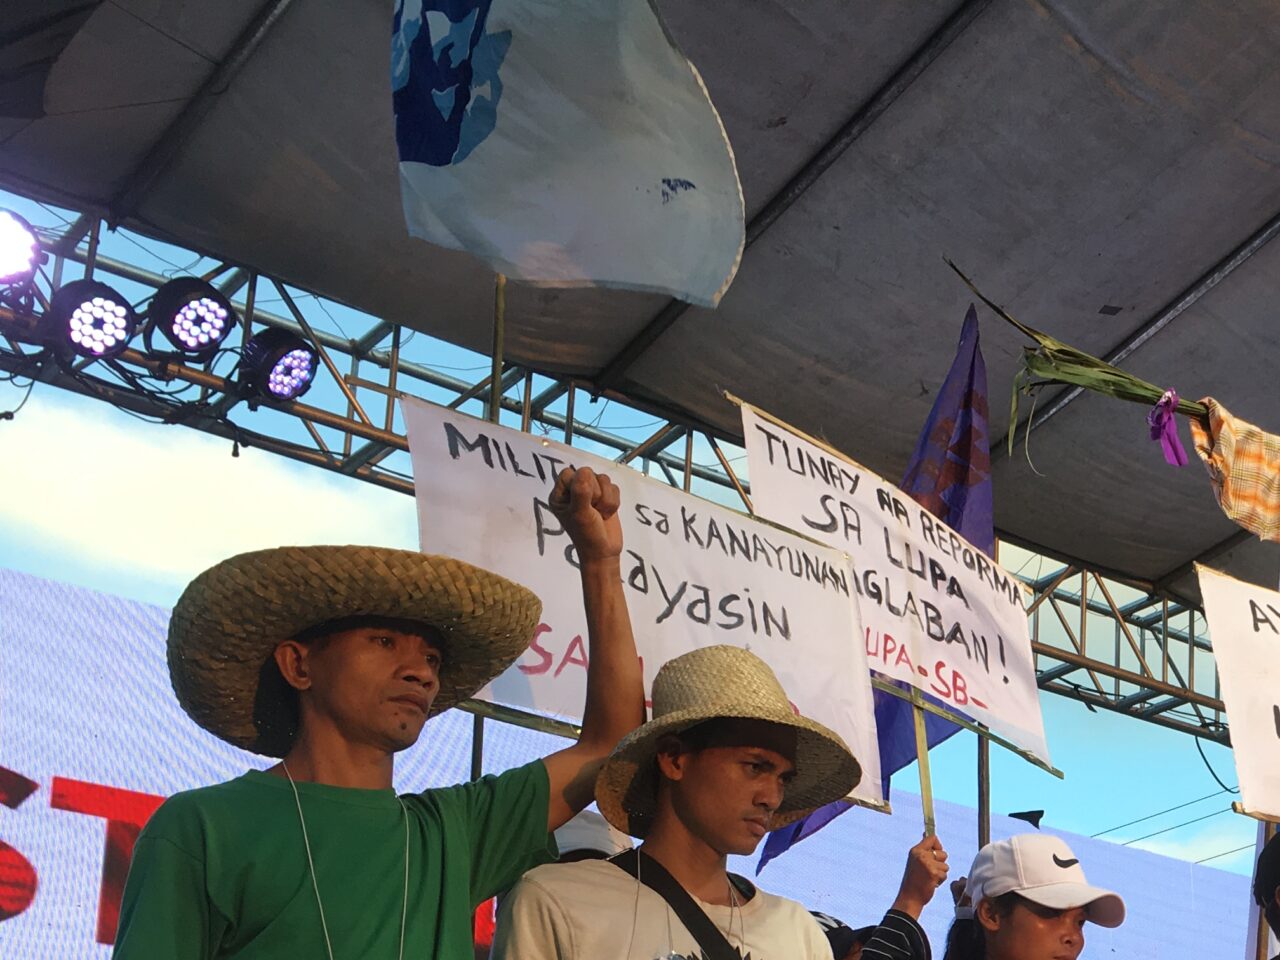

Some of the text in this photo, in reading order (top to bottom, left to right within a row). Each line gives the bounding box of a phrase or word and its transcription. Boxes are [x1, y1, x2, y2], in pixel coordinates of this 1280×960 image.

[680, 505, 850, 598] KANAYUNAN
[755, 423, 860, 495] TUNAY
[919, 511, 1025, 612] REPORMA
[801, 494, 970, 609] SA LUPA
